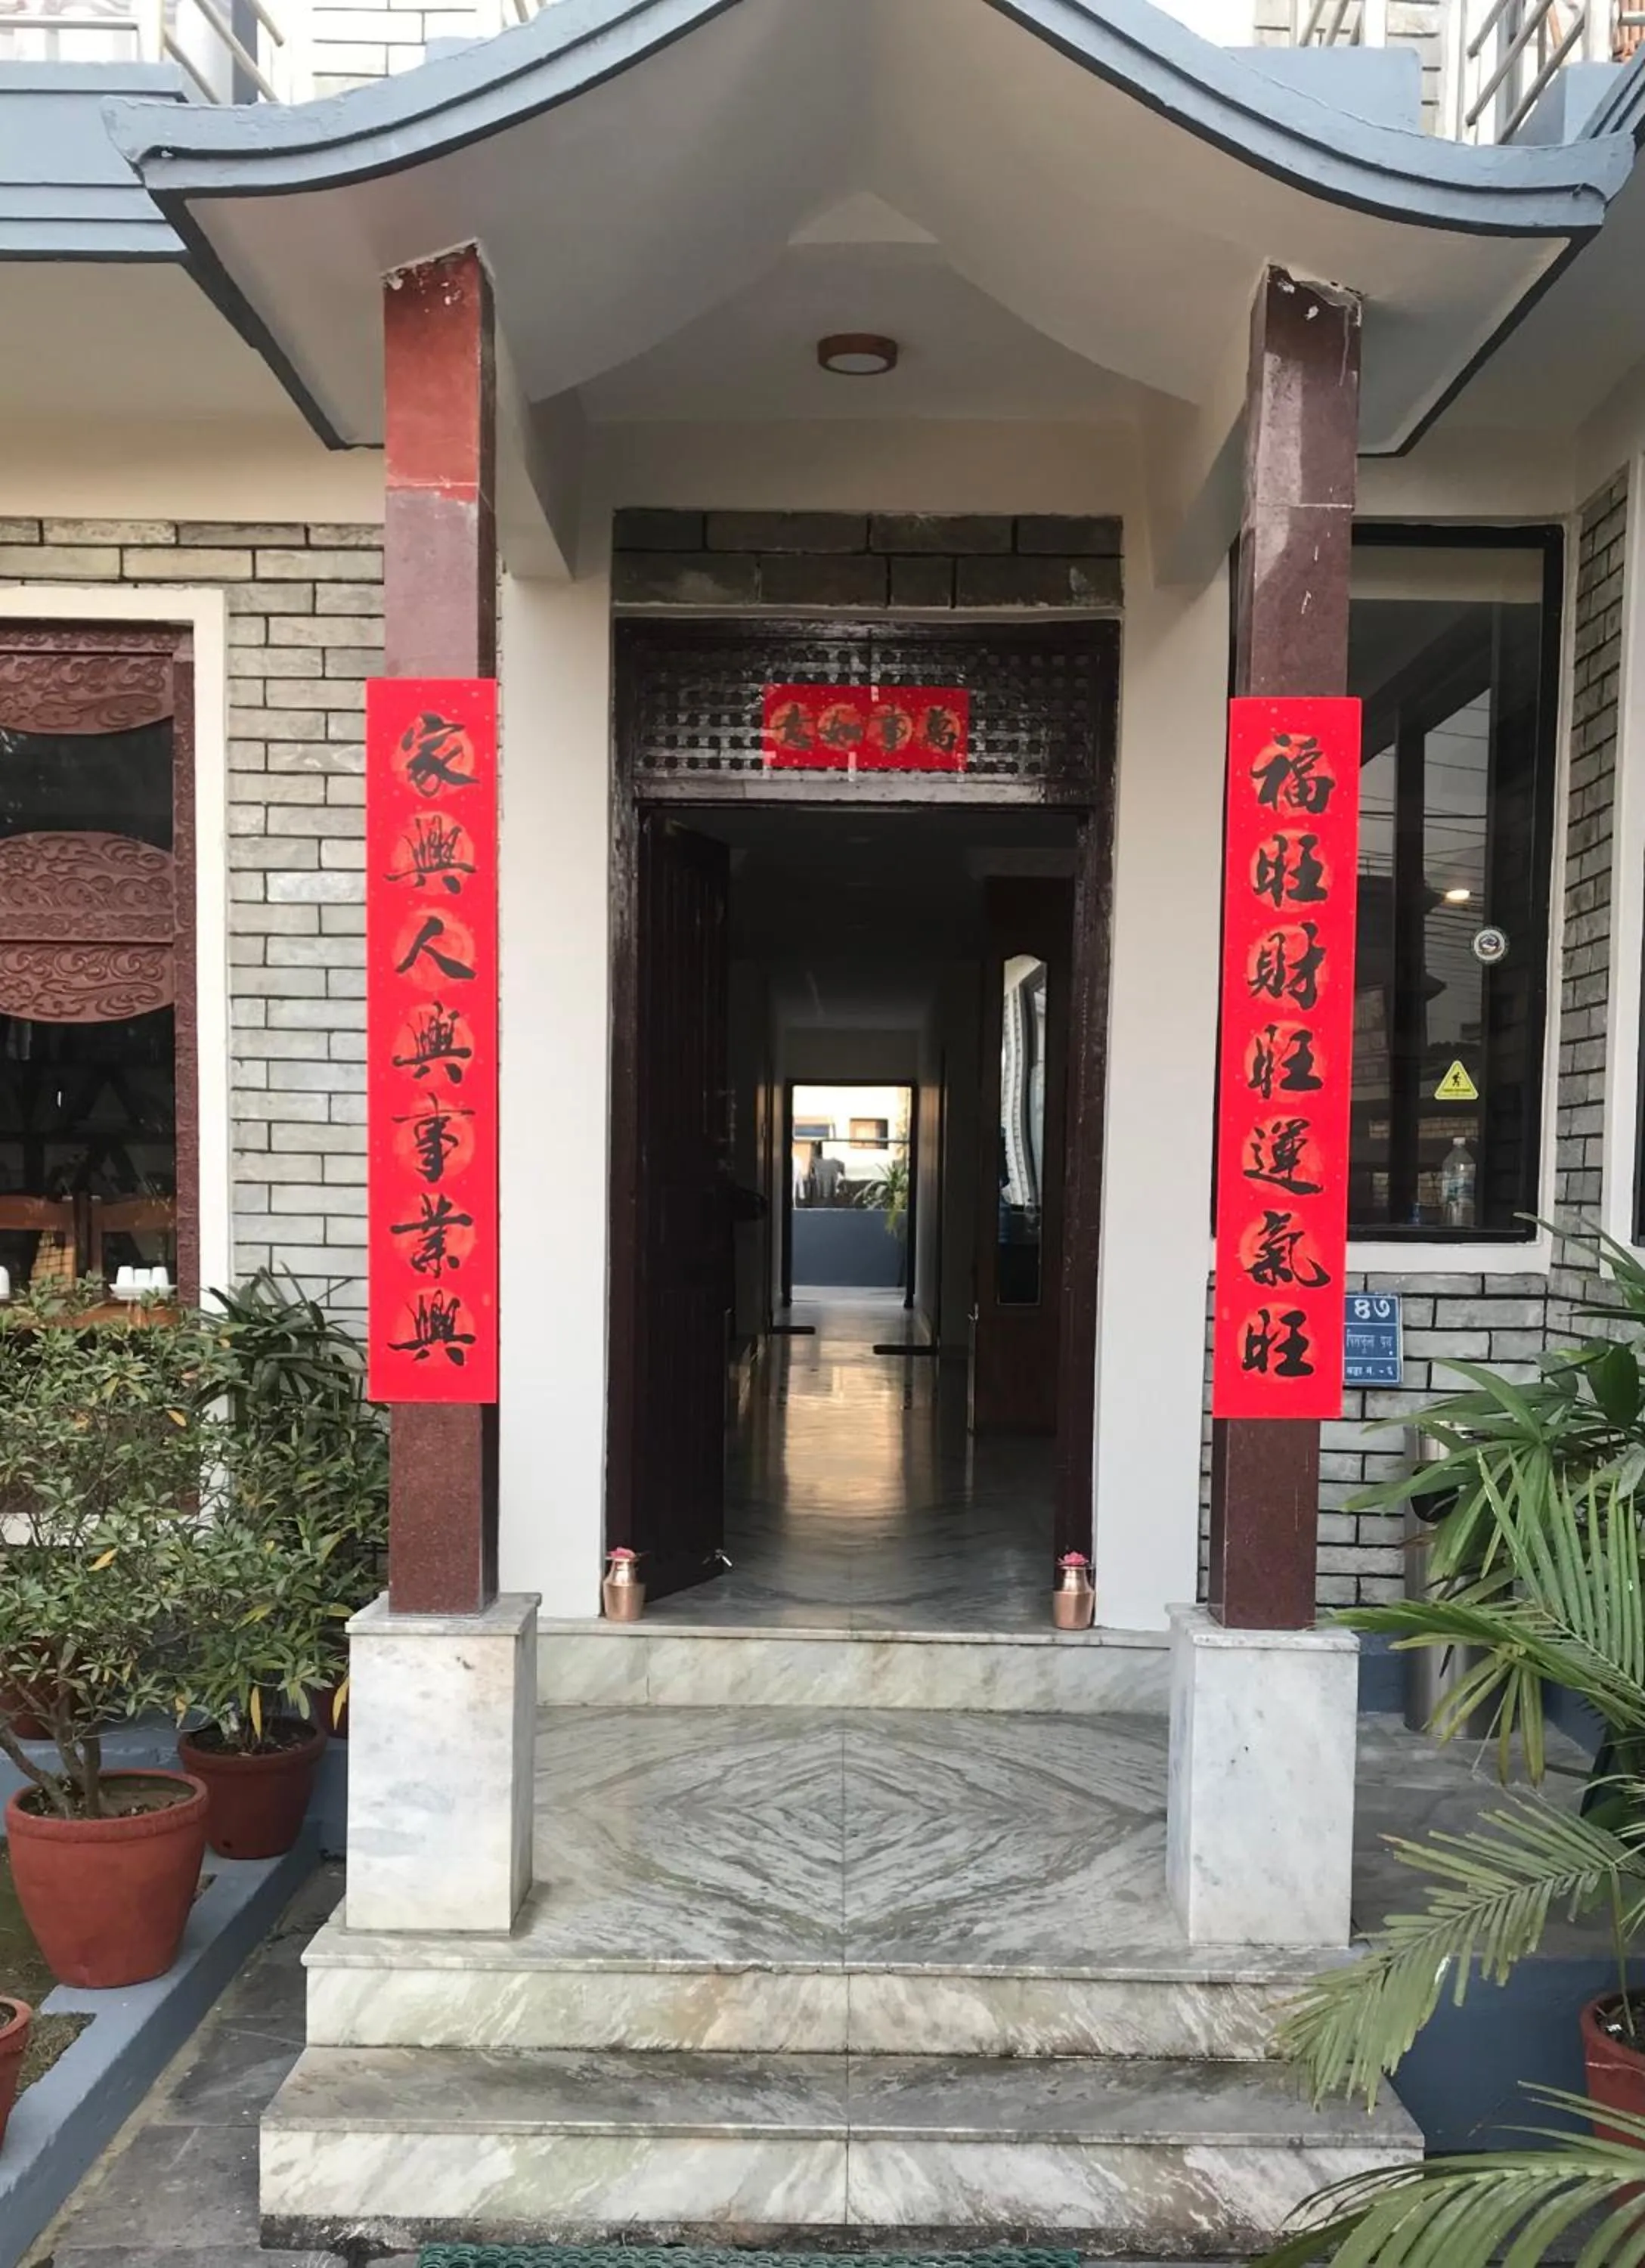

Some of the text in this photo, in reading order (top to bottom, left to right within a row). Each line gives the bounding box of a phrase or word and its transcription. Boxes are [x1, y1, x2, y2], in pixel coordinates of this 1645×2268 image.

[383, 712, 479, 1368] 家興人興事業興
[1241, 732, 1335, 1377] 福旺財旺運氣旺
